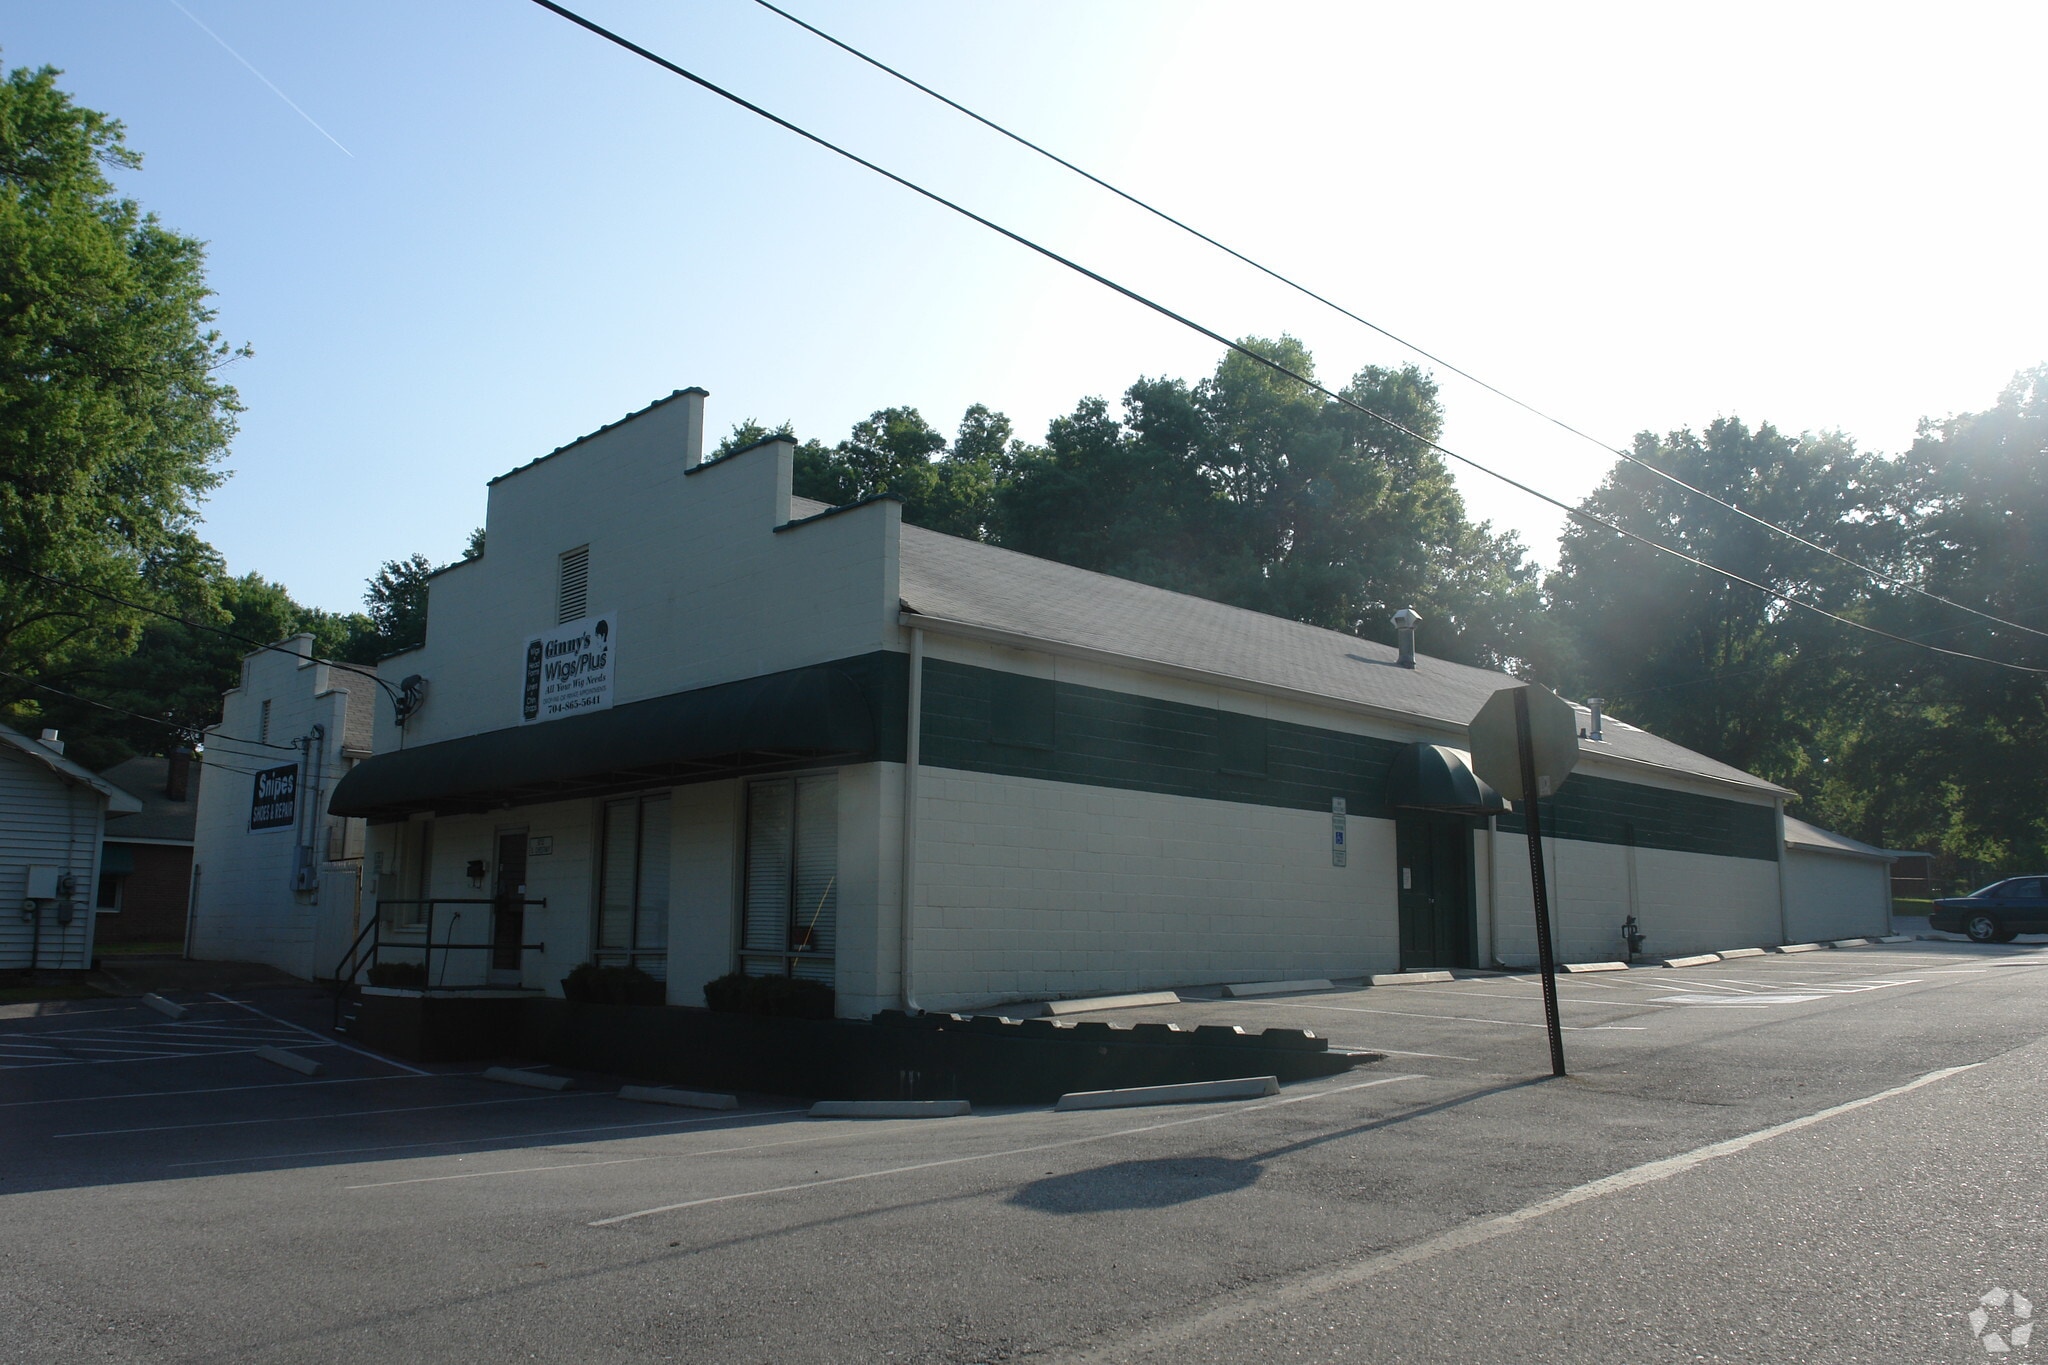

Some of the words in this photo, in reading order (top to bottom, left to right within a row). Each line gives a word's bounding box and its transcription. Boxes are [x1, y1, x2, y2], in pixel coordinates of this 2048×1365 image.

[545, 631, 591, 659] Ginny's
[545, 684, 555, 695] All
[557, 681, 571, 692] Your
[573, 678, 585, 688] Wig
[586, 673, 606, 686] Needs
[548, 695, 600, 714] 704-865-5641
[258, 771, 294, 800] Snipes
[253, 804, 270, 822] SHOES
[275, 800, 294, 819] REPAIR
